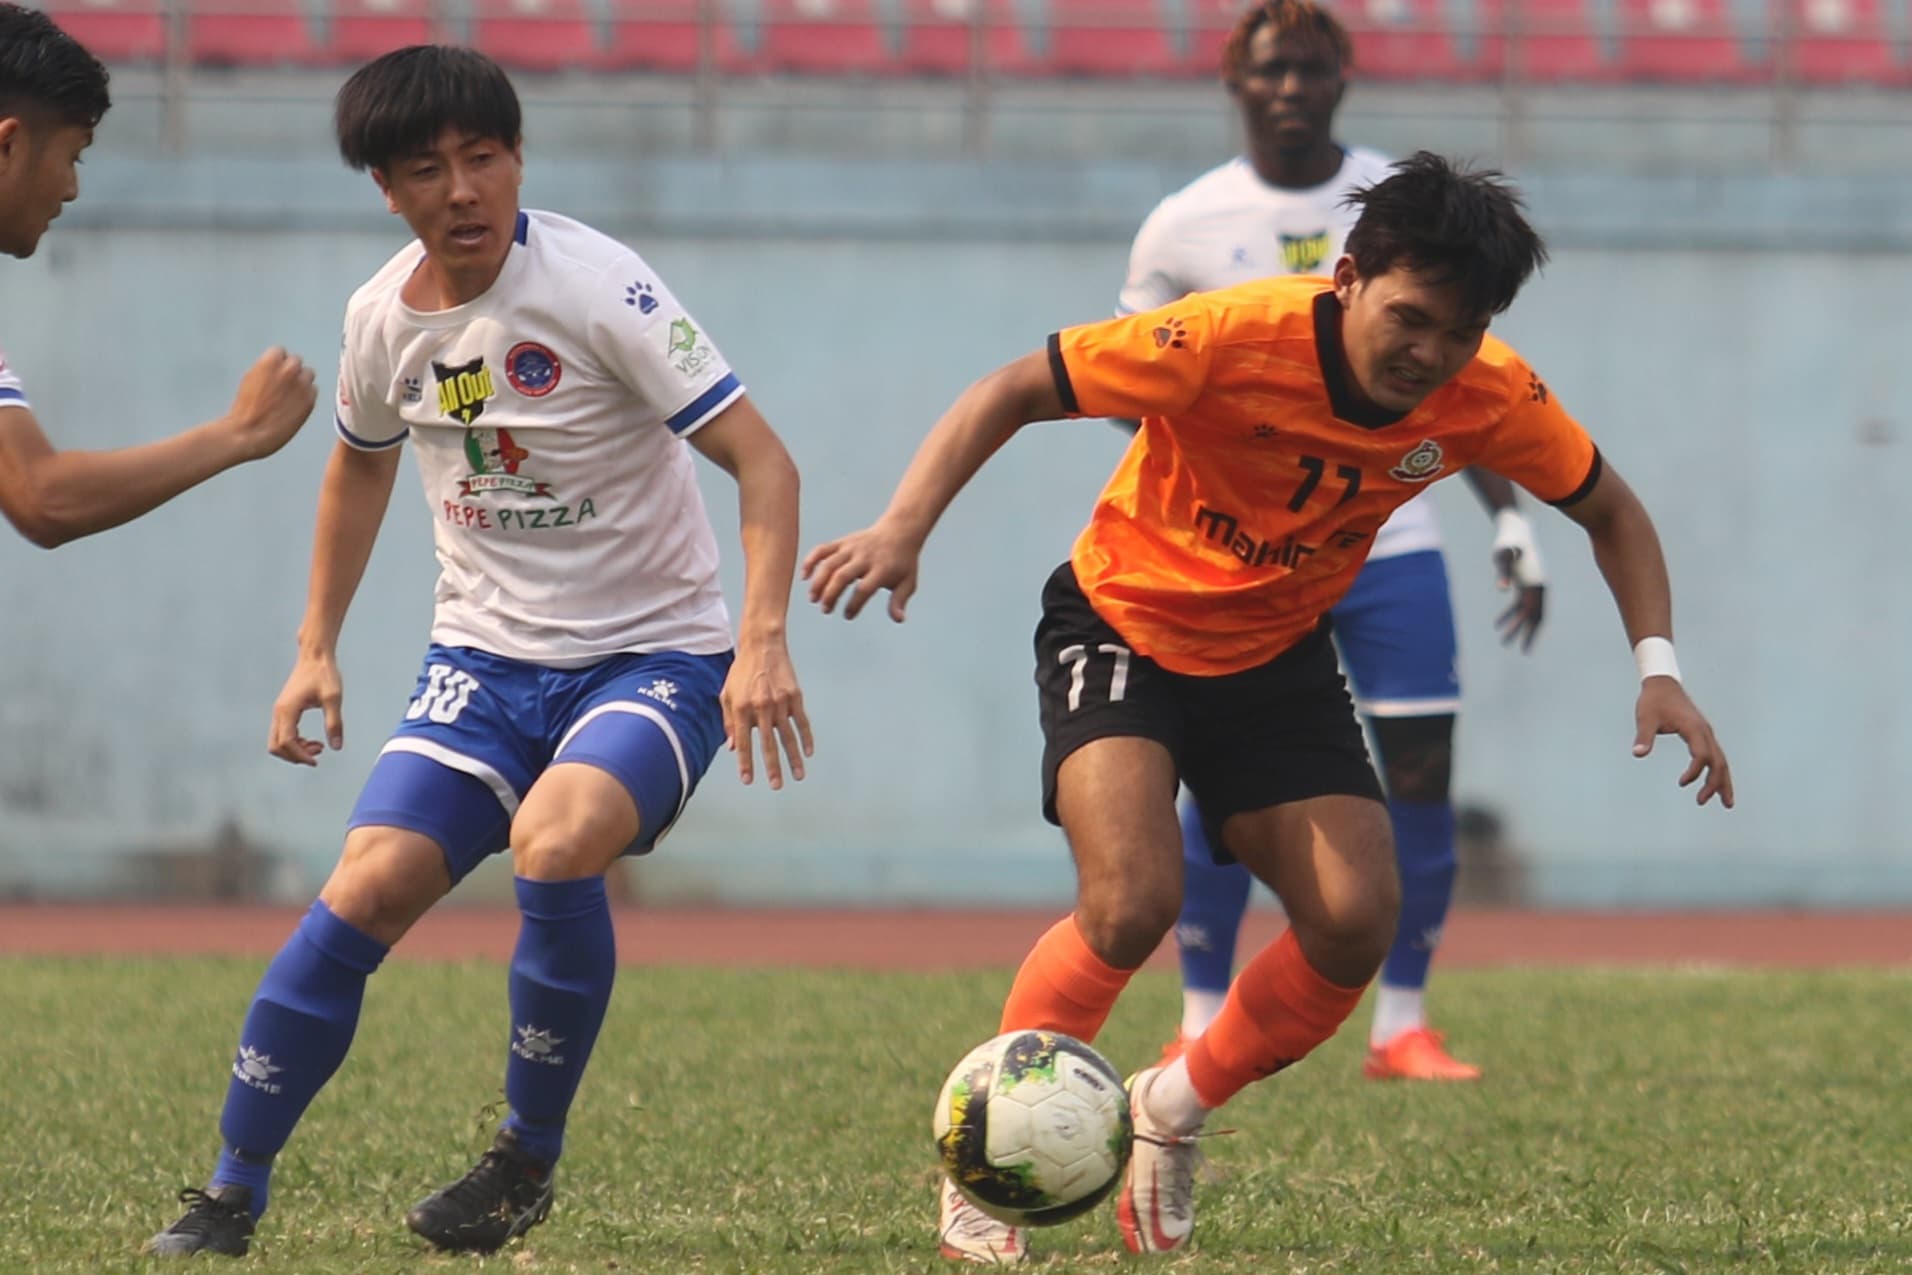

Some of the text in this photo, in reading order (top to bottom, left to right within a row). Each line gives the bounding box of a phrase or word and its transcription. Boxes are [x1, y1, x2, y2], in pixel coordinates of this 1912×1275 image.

[443, 498, 597, 530] PEPE PIZZA
[1058, 643, 1131, 713] 77
